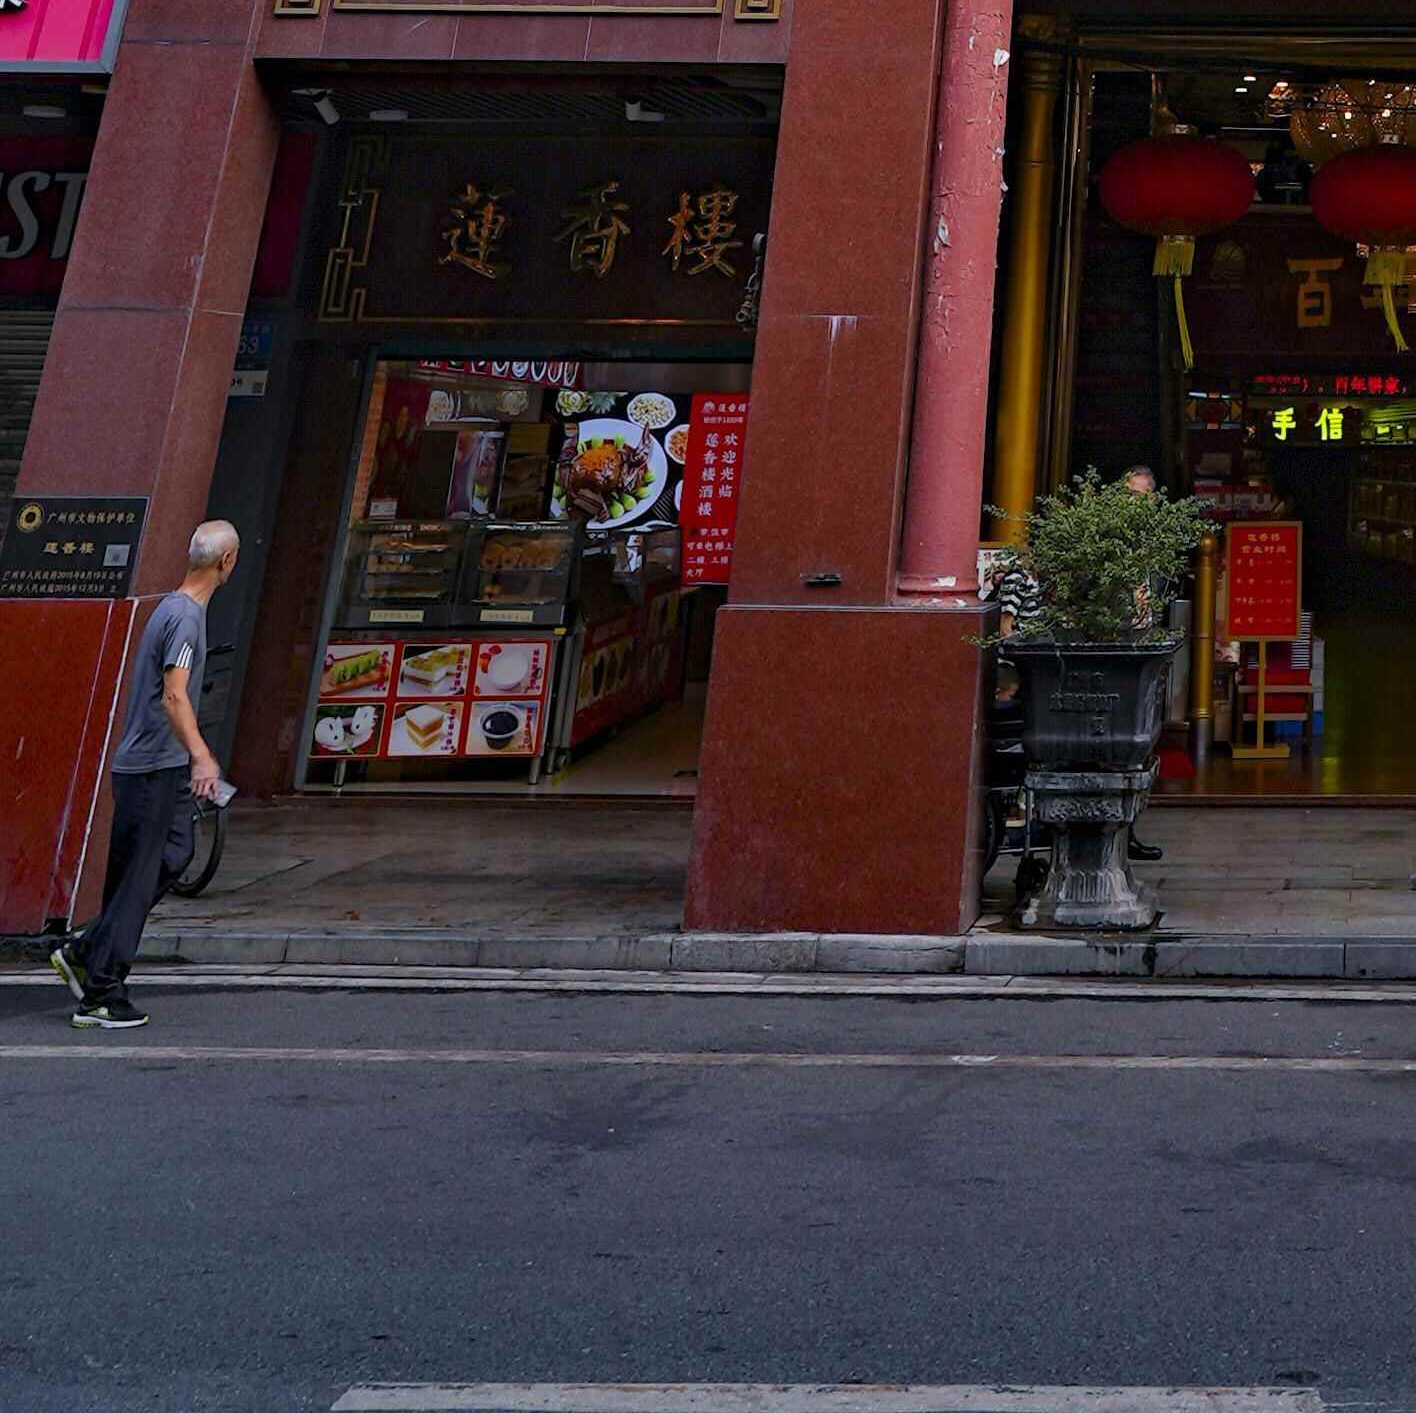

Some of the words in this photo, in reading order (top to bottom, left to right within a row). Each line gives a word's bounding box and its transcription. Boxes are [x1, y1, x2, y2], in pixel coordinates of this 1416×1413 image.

[435, 180, 745, 280] 蓮香樓
[1271, 405, 1345, 441] 手信
[717, 432, 739, 499] 欢迎光临
